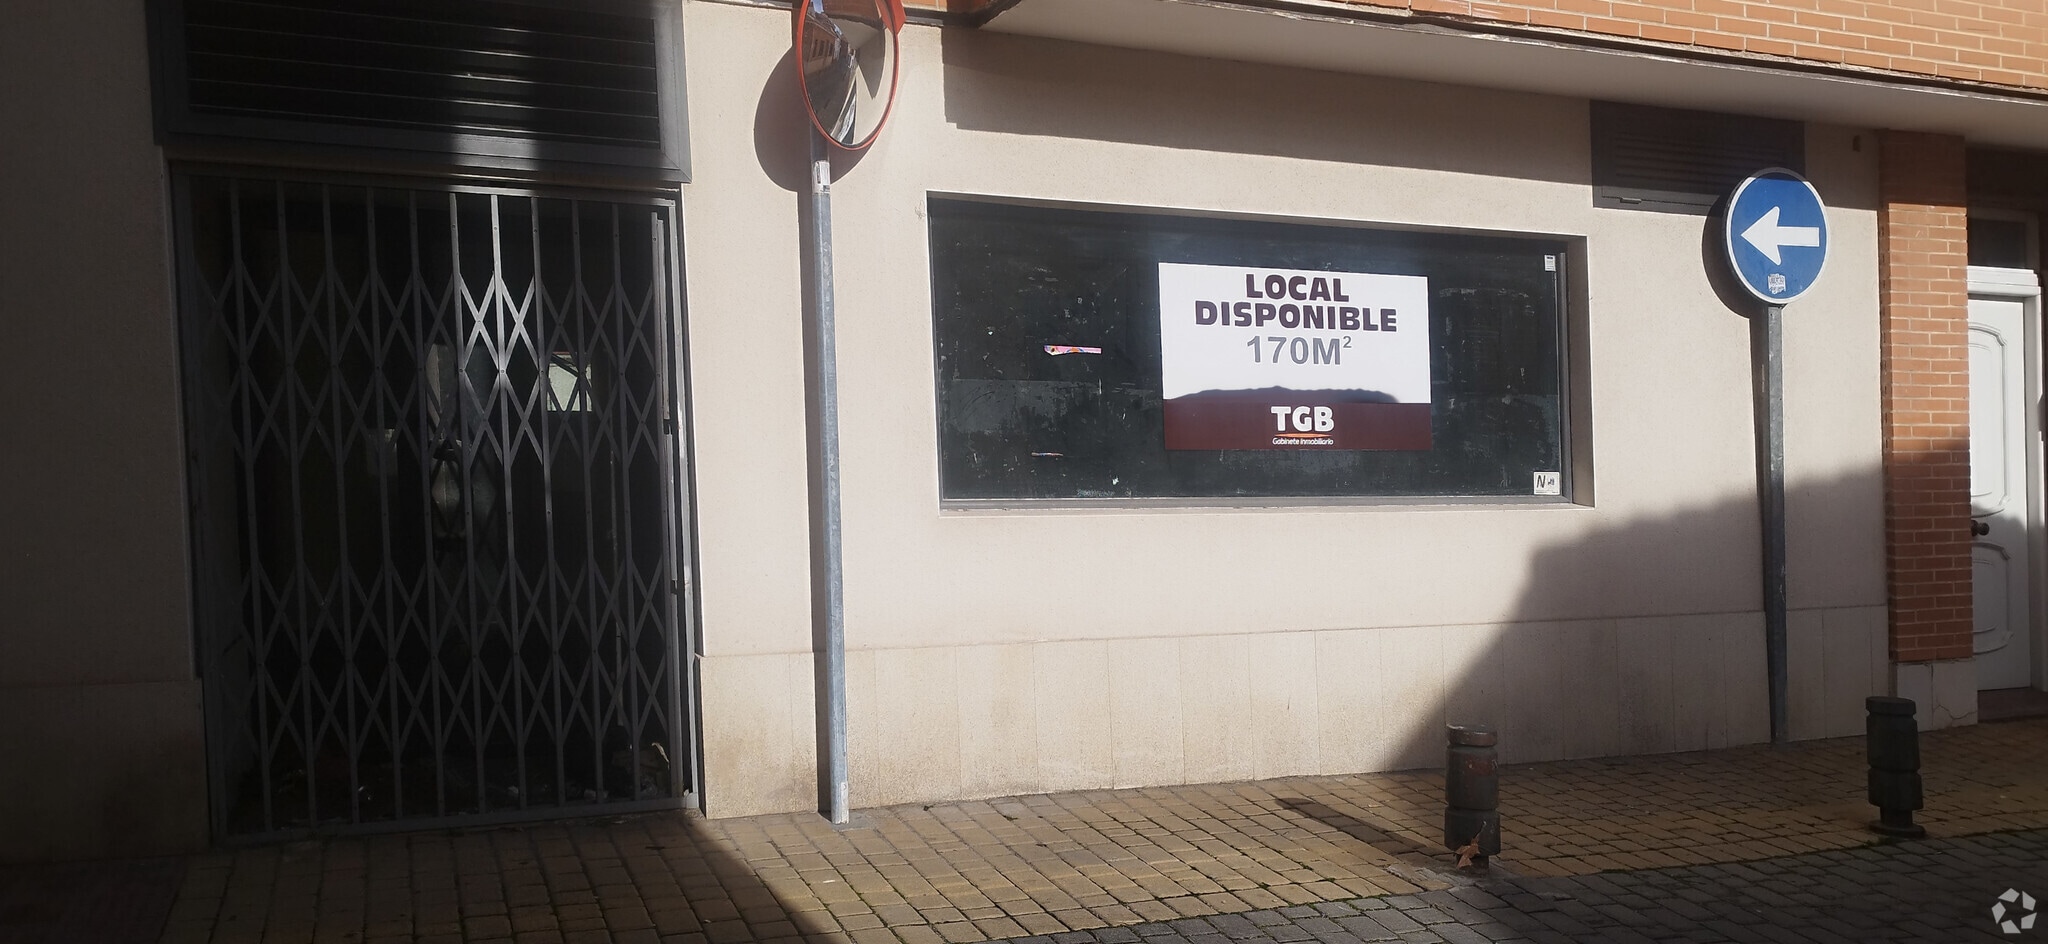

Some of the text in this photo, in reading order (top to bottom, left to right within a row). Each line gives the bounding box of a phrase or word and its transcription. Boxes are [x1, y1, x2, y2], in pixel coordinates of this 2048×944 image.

[1245, 273, 1349, 302] LOCAL
[1195, 300, 1397, 332] DISPONIBLE
[1271, 406, 1334, 431] TGB
[1272, 437, 1299, 445] Gabinete
